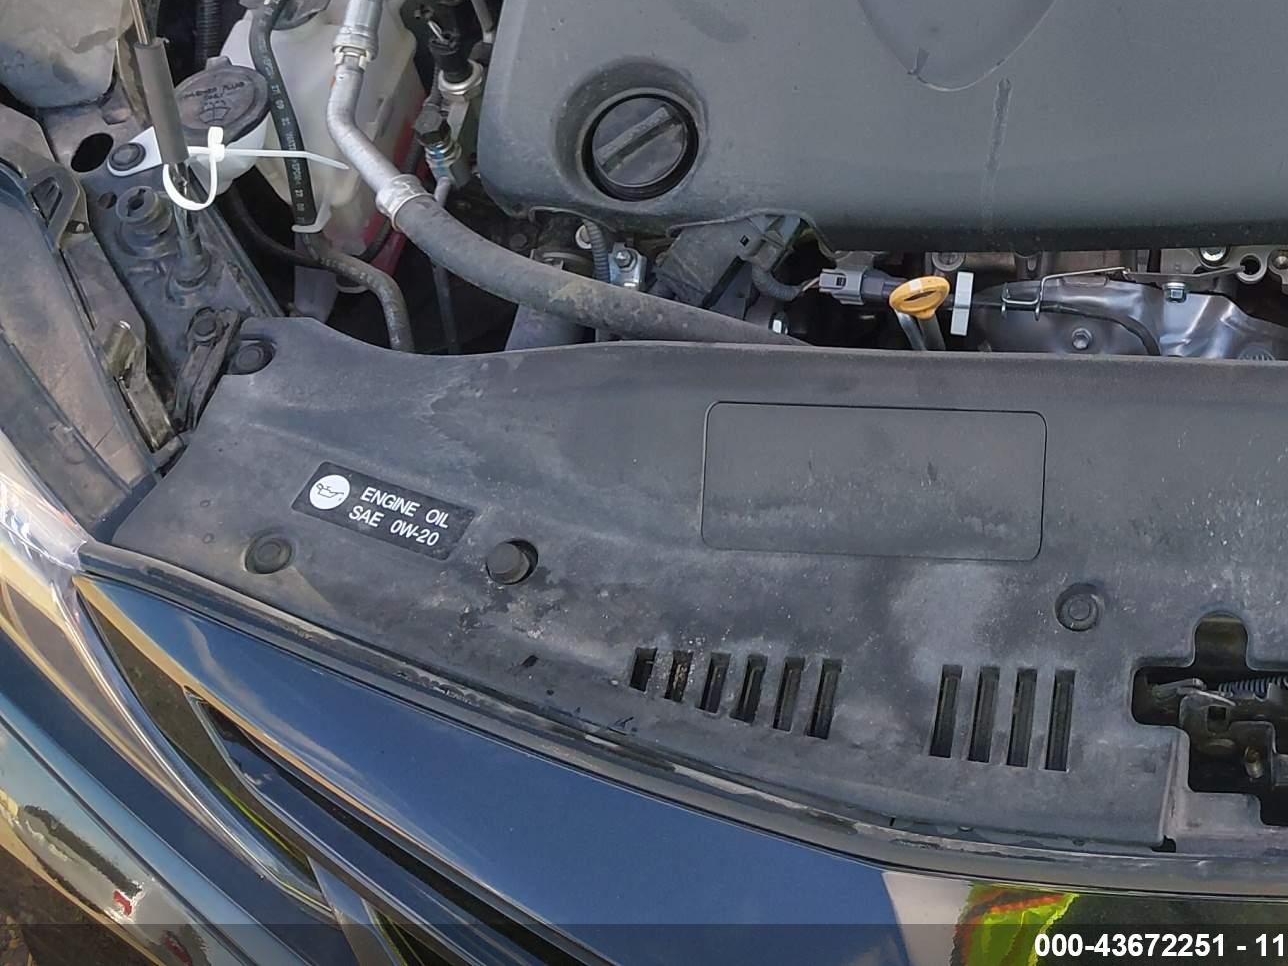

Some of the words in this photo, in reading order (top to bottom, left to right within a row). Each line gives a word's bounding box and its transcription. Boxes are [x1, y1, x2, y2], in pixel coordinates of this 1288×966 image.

[348, 505, 385, 528] SAE
[390, 519, 440, 546] 0W-20
[360, 487, 421, 518] ENGINE
[425, 509, 450, 529] OIL
